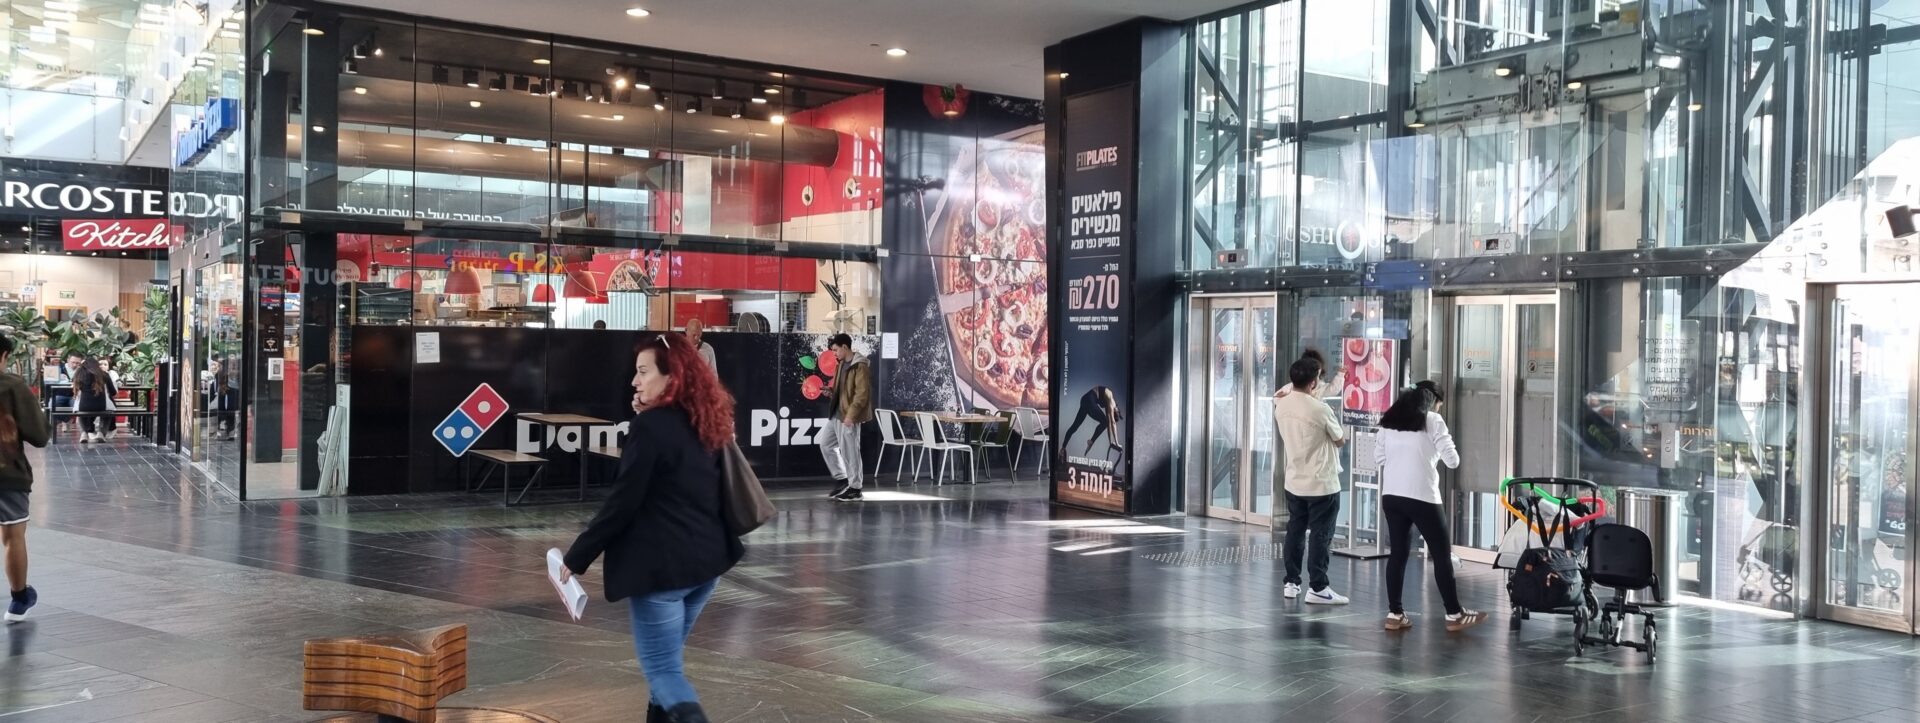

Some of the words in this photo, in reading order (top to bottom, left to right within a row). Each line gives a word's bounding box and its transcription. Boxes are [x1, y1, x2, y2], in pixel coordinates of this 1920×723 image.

[0, 181, 164, 215] RCOSTE
[1072, 190, 1122, 214] פילאטיס
[69, 222, 169, 249] Kitch
[1071, 213, 1121, 236] מכשירים
[1071, 239, 1084, 250] סבא
[1085, 238, 1097, 249] כפר
[751, 406, 832, 447] Pizz
[1068, 466, 1076, 489] 3
[1081, 471, 1113, 499] קומה
